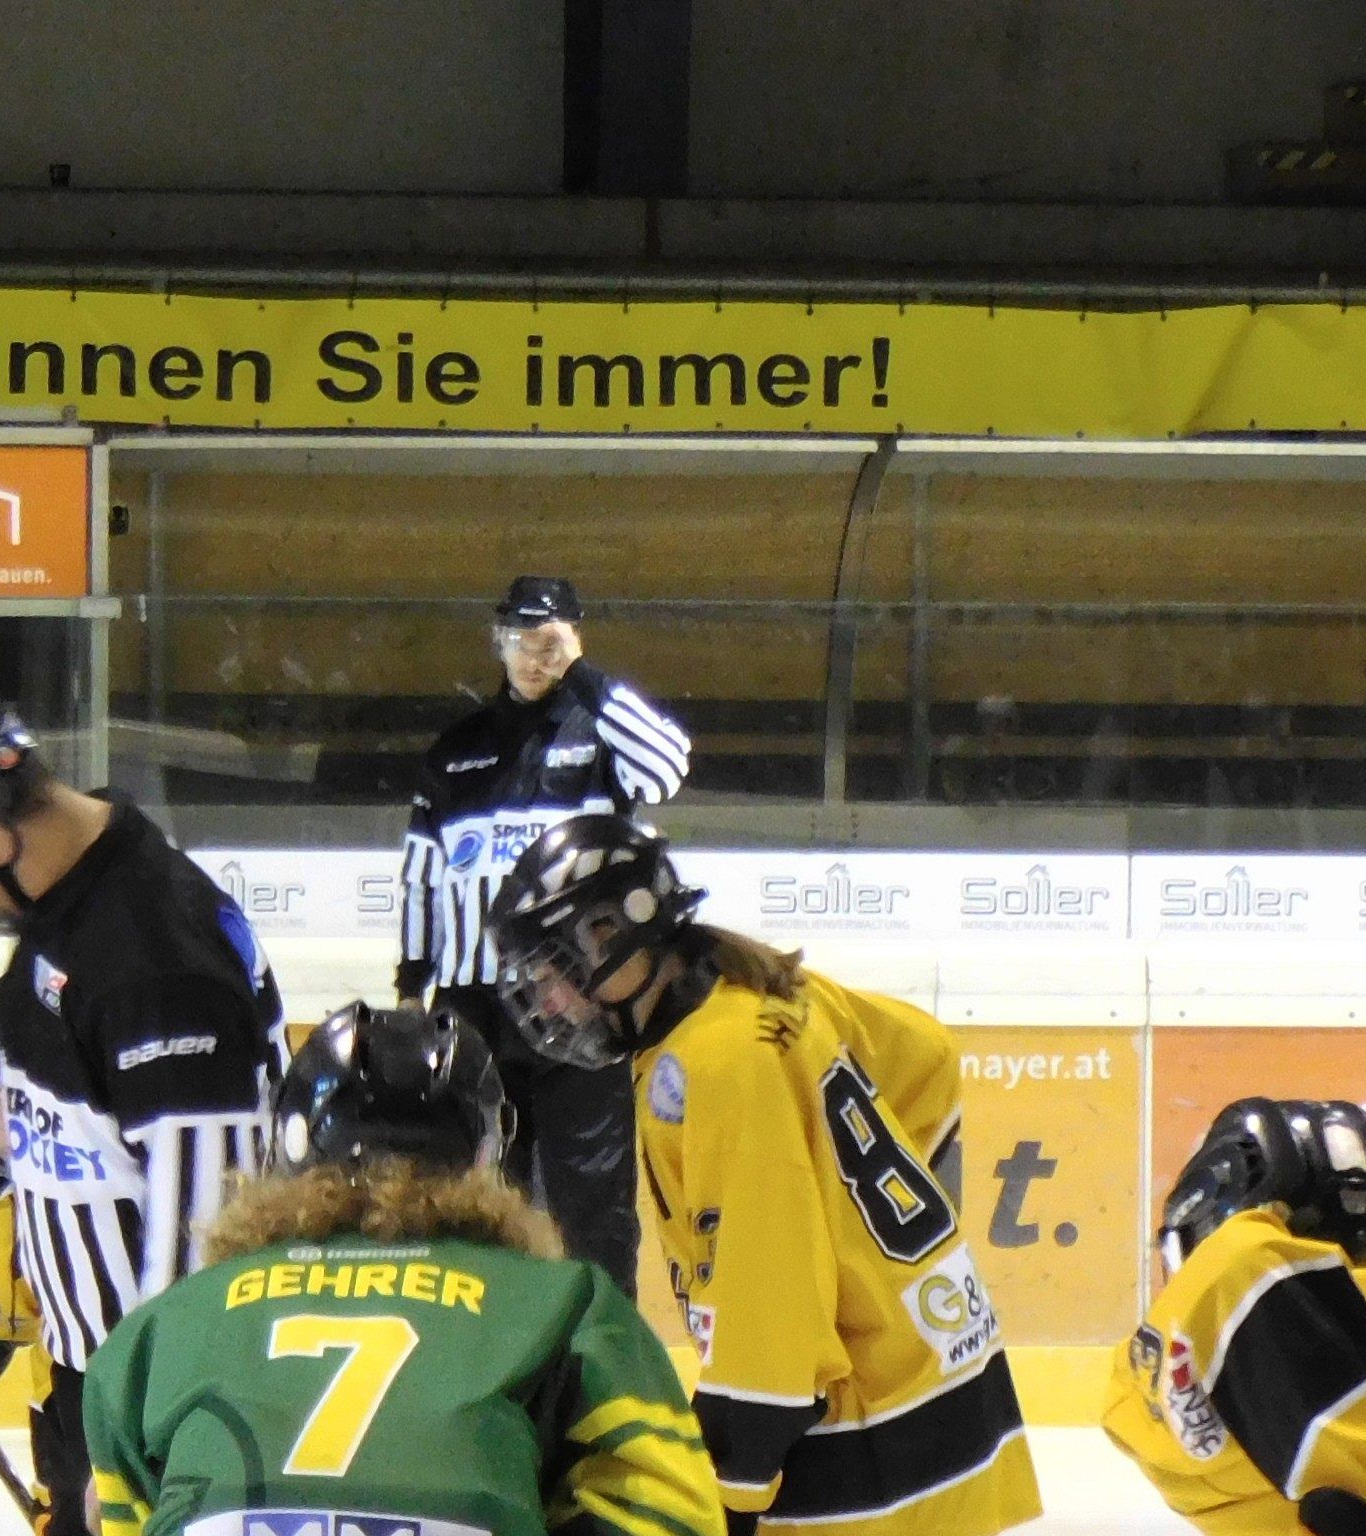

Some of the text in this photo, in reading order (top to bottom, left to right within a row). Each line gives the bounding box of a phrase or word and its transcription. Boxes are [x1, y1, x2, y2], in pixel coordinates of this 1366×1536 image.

[316, 330, 481, 404] Sie
[525, 335, 892, 408] immer!
[760, 867, 910, 914] Soller
[961, 867, 1110, 915] Soller
[1159, 869, 1309, 917] Soller
[225, 1261, 486, 1316] GEHRER
[266, 1313, 419, 1478] 7
